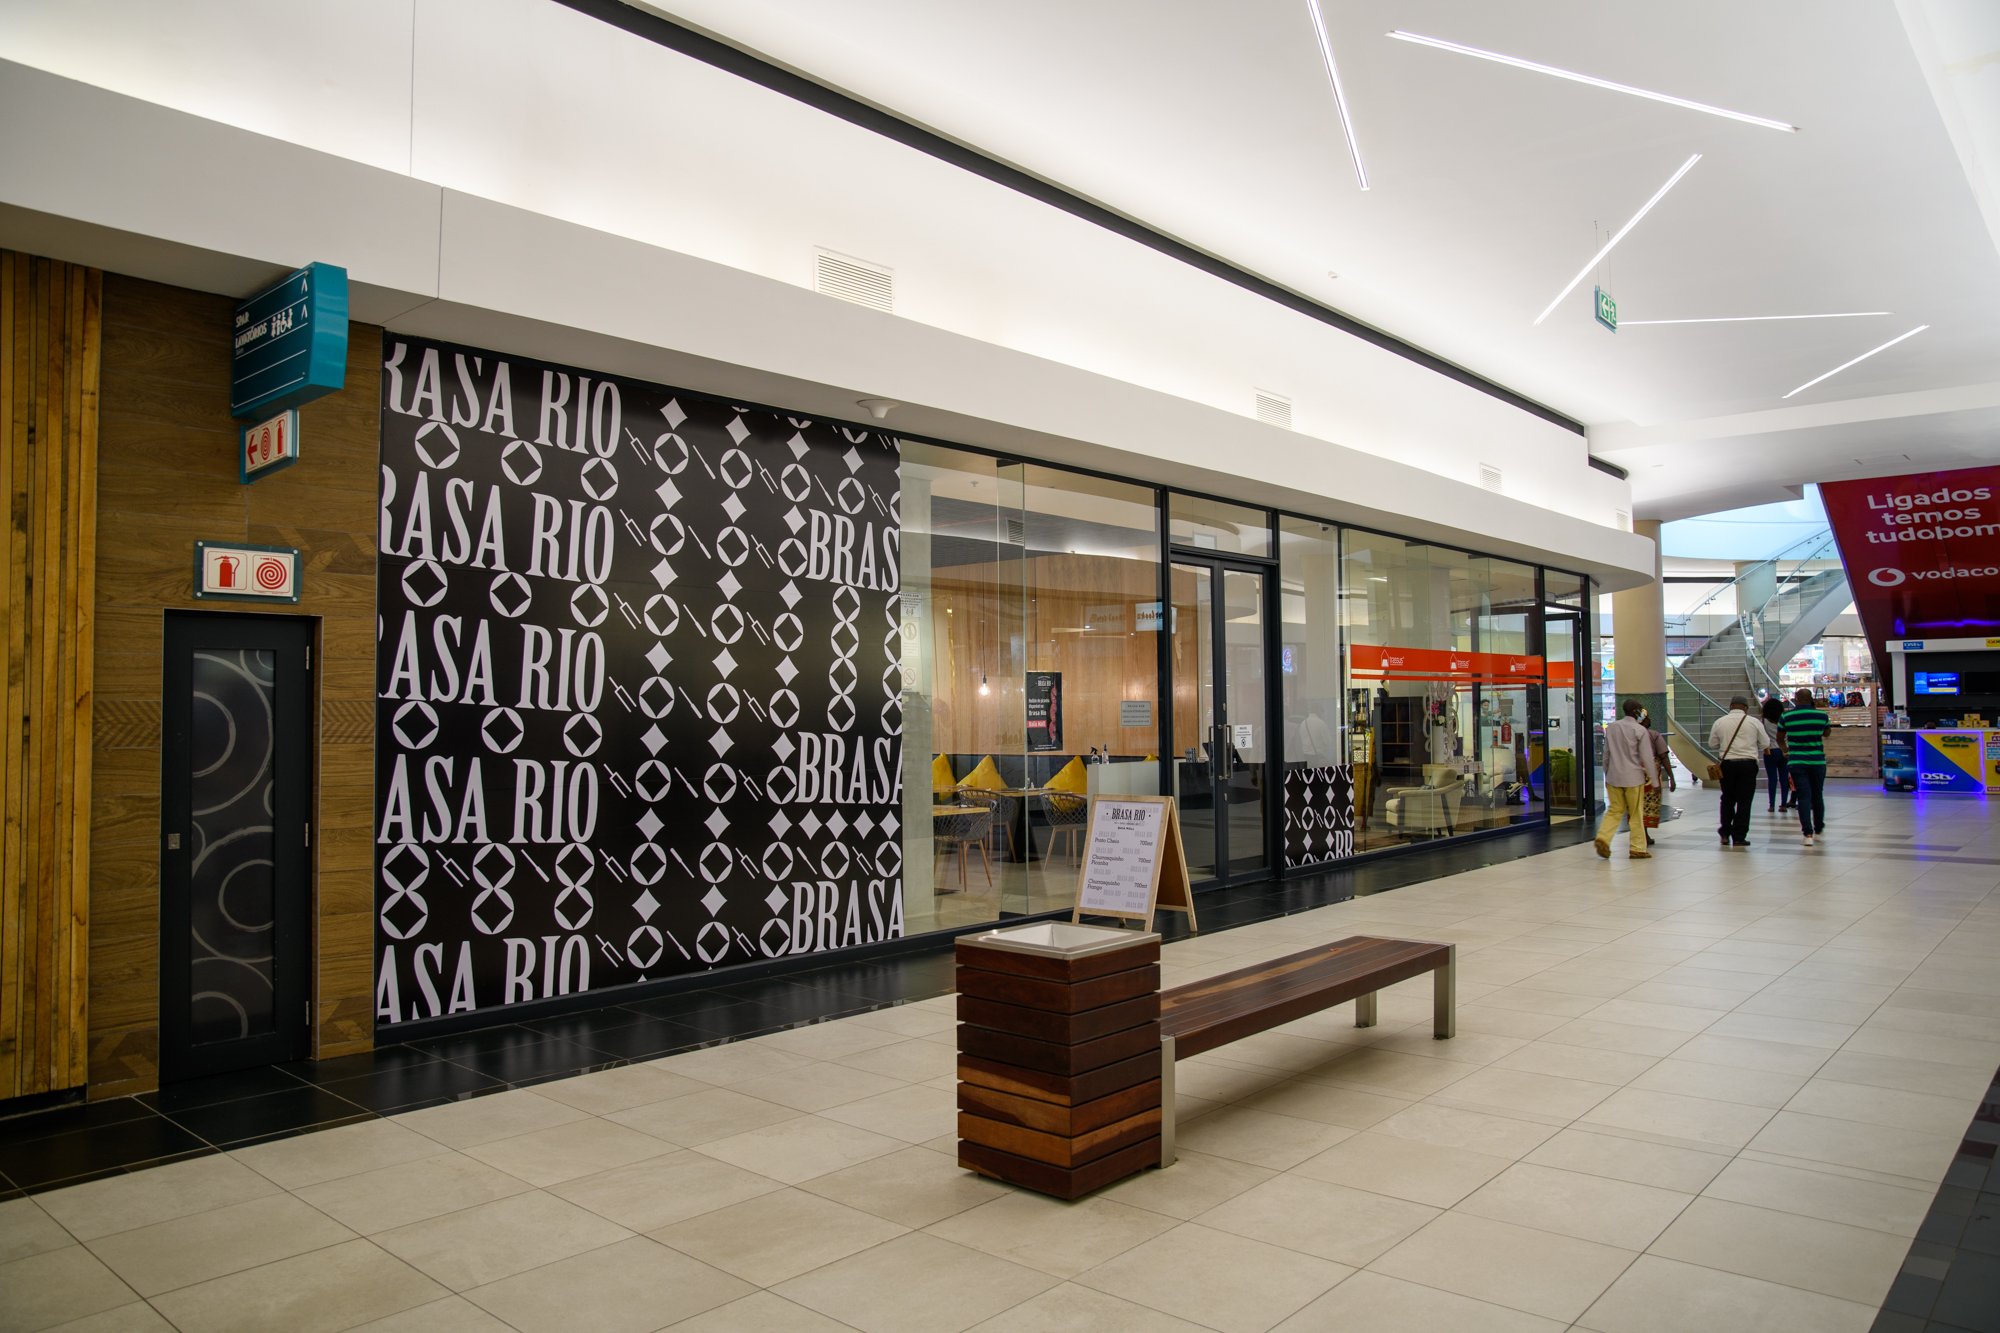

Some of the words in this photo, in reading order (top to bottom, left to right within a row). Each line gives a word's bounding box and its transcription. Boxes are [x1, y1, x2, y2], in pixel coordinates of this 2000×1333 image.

[534, 370, 621, 458] RIO
[525, 492, 615, 584] RIO
[1867, 488, 1991, 510] Ligados
[1882, 507, 1981, 525] temos
[805, 508, 899, 593] BRAS
[1911, 566, 2000, 580] vodaco
[379, 610, 499, 706] ASA
[515, 623, 605, 713] RIO
[377, 753, 492, 844] ASA
[508, 758, 598, 843] RIO
[1112, 808, 1132, 820] BRASA
[1134, 809, 1145, 821] RIO
[788, 879, 904, 954] BRASA
[377, 940, 476, 1024] ASA
[503, 934, 591, 1004] RIO
